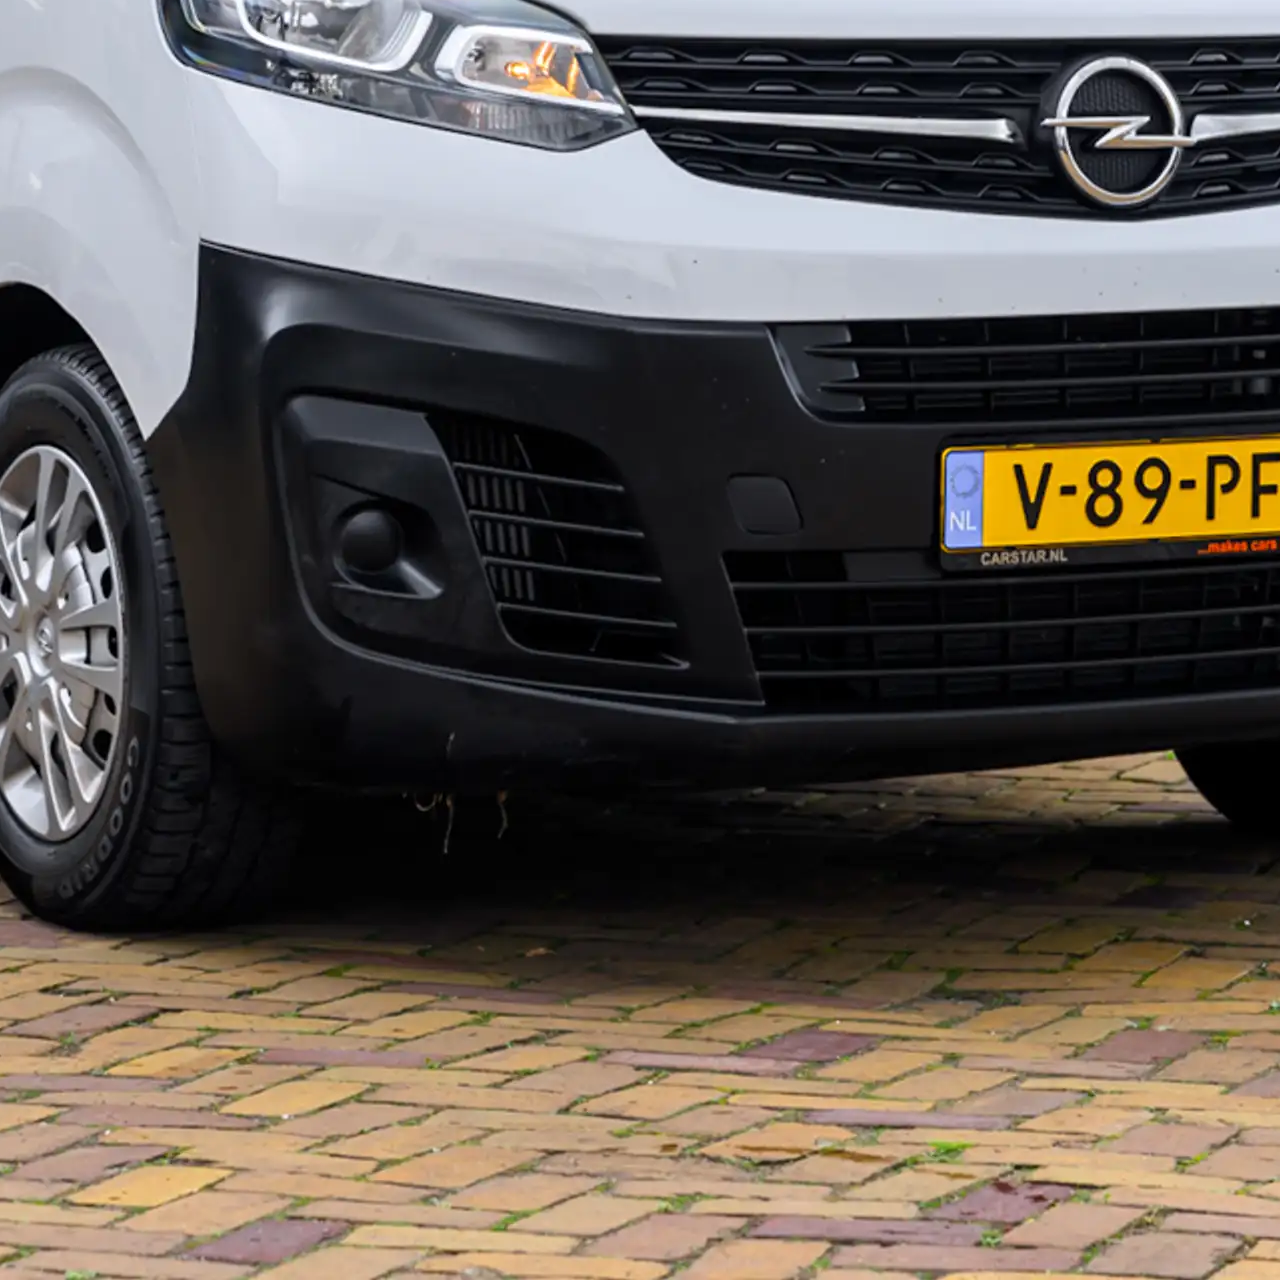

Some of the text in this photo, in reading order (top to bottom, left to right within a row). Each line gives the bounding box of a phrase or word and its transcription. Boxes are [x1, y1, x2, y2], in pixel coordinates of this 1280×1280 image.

[949, 510, 977, 532] NL
[1249, 537, 1279, 553] cars
[980, 548, 1069, 567] CARSTAR.NL
[48, 735, 141, 903] GOODRID
